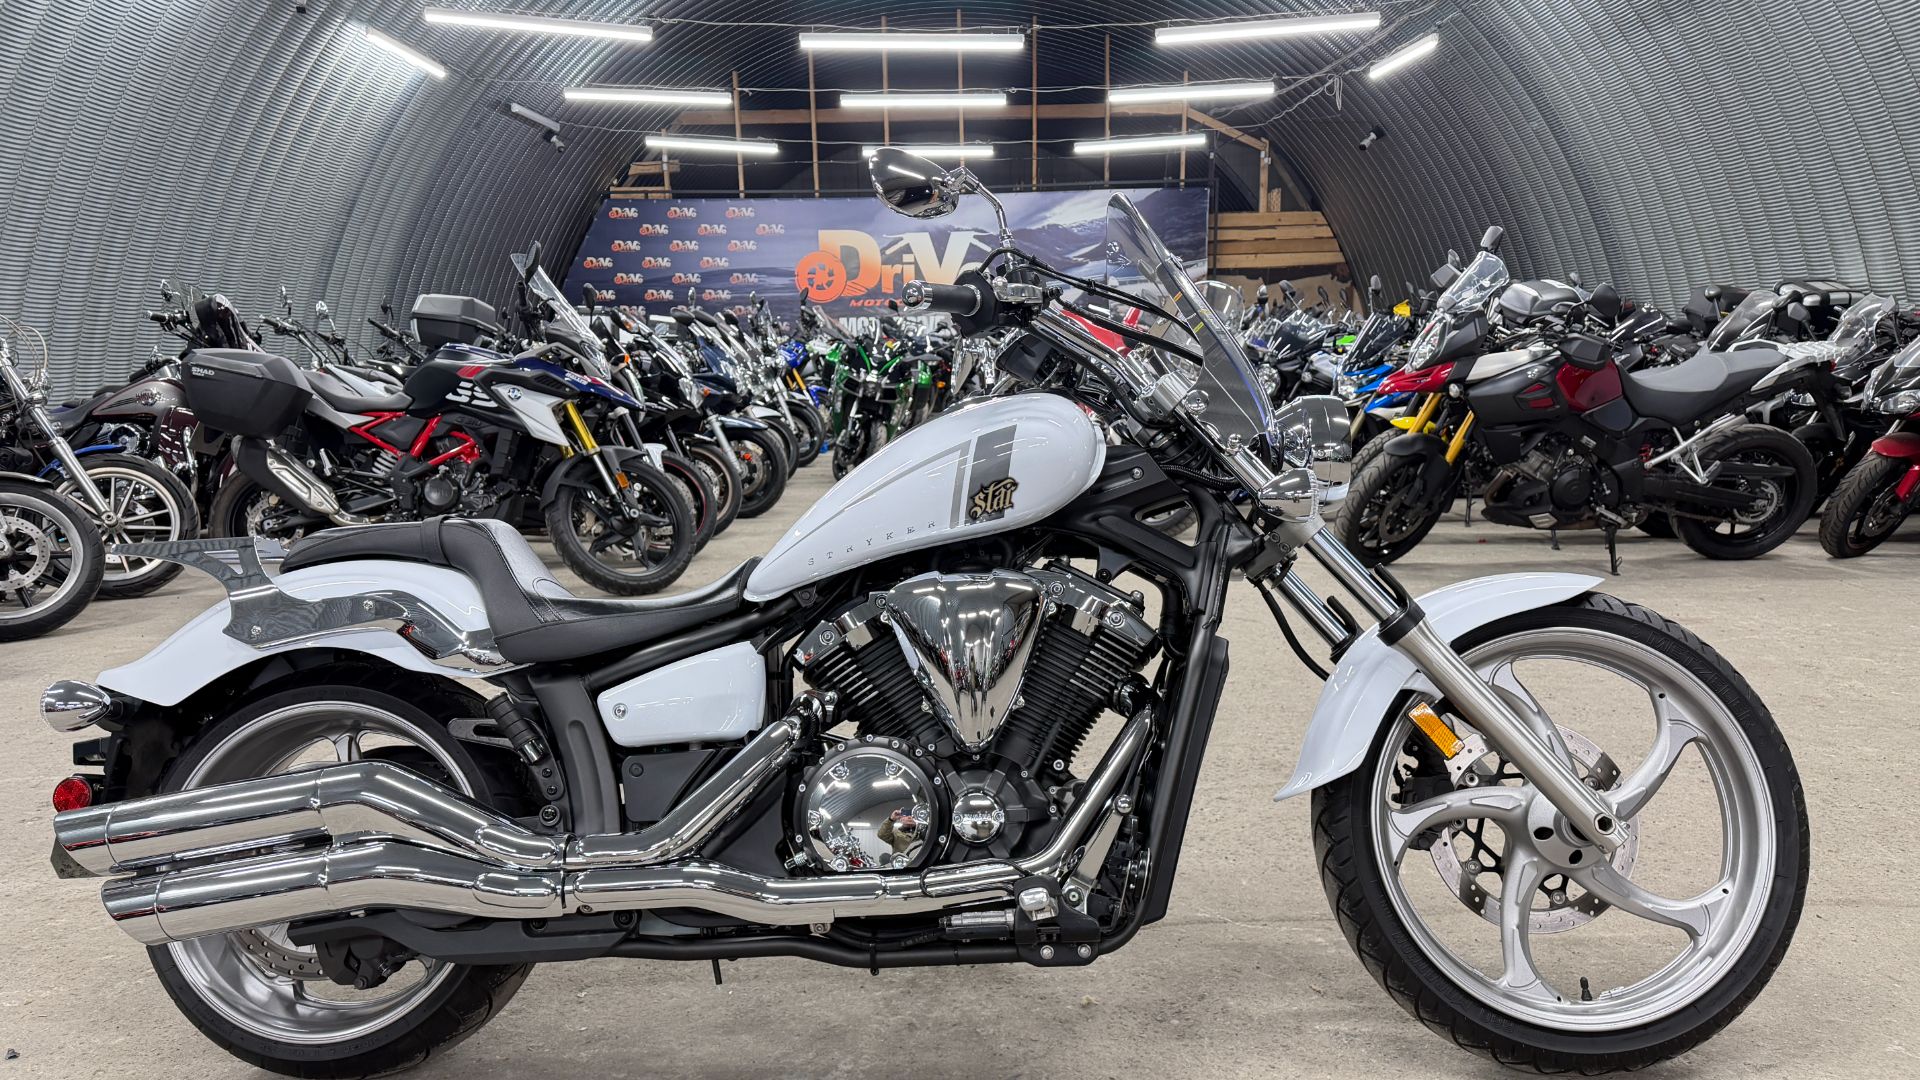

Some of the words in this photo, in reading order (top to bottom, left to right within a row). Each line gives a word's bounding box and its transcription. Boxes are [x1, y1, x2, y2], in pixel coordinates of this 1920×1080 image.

[191, 366, 215, 376] SHAD
[445, 381, 499, 408] GS
[970, 477, 1018, 519] star
[808, 520, 936, 566] STRYKER
